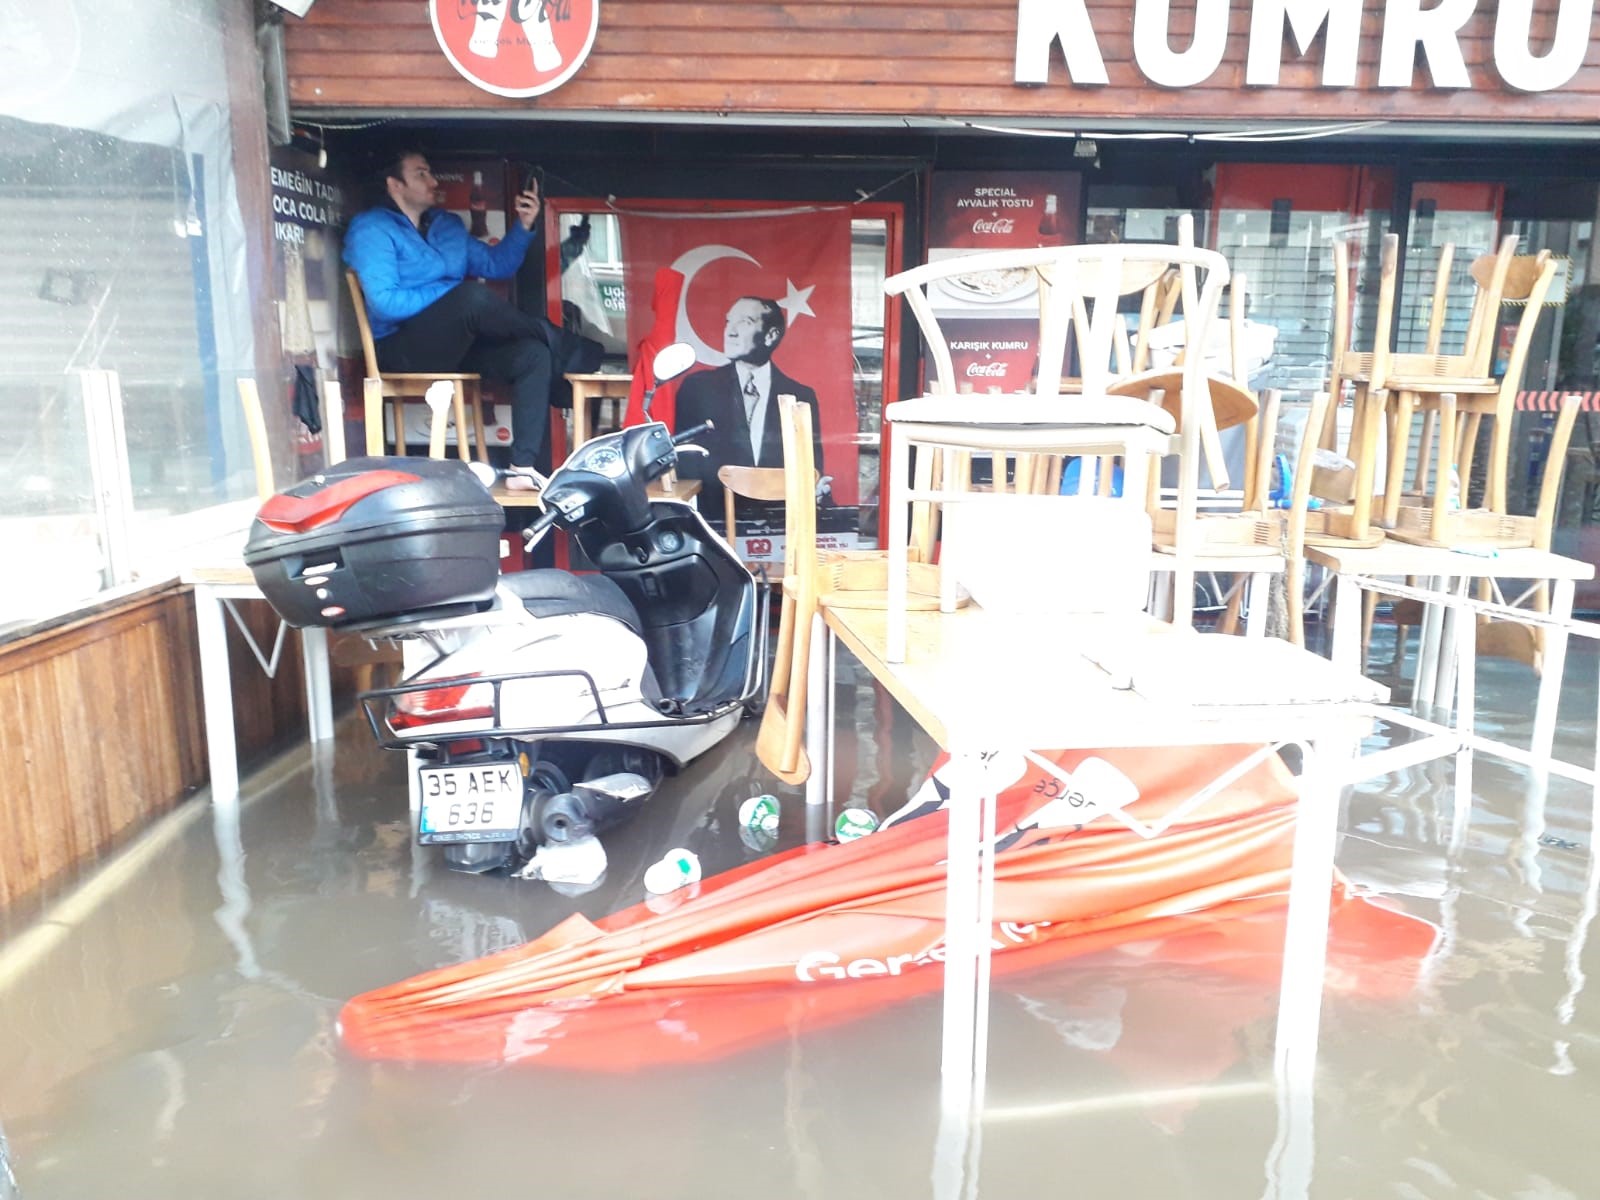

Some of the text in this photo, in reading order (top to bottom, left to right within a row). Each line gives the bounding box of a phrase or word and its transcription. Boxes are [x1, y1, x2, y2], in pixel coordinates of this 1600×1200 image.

[1014, 0, 1594, 91] KUMRU
[974, 187, 1017, 197] SPECIAL
[299, 202, 327, 224] COLA
[956, 199, 1034, 208] AYVALIK TOSTU
[950, 341, 1028, 352] KARIŞIK KUMRU
[428, 770, 512, 796] 35 AEK
[448, 802, 494, 826] 636
